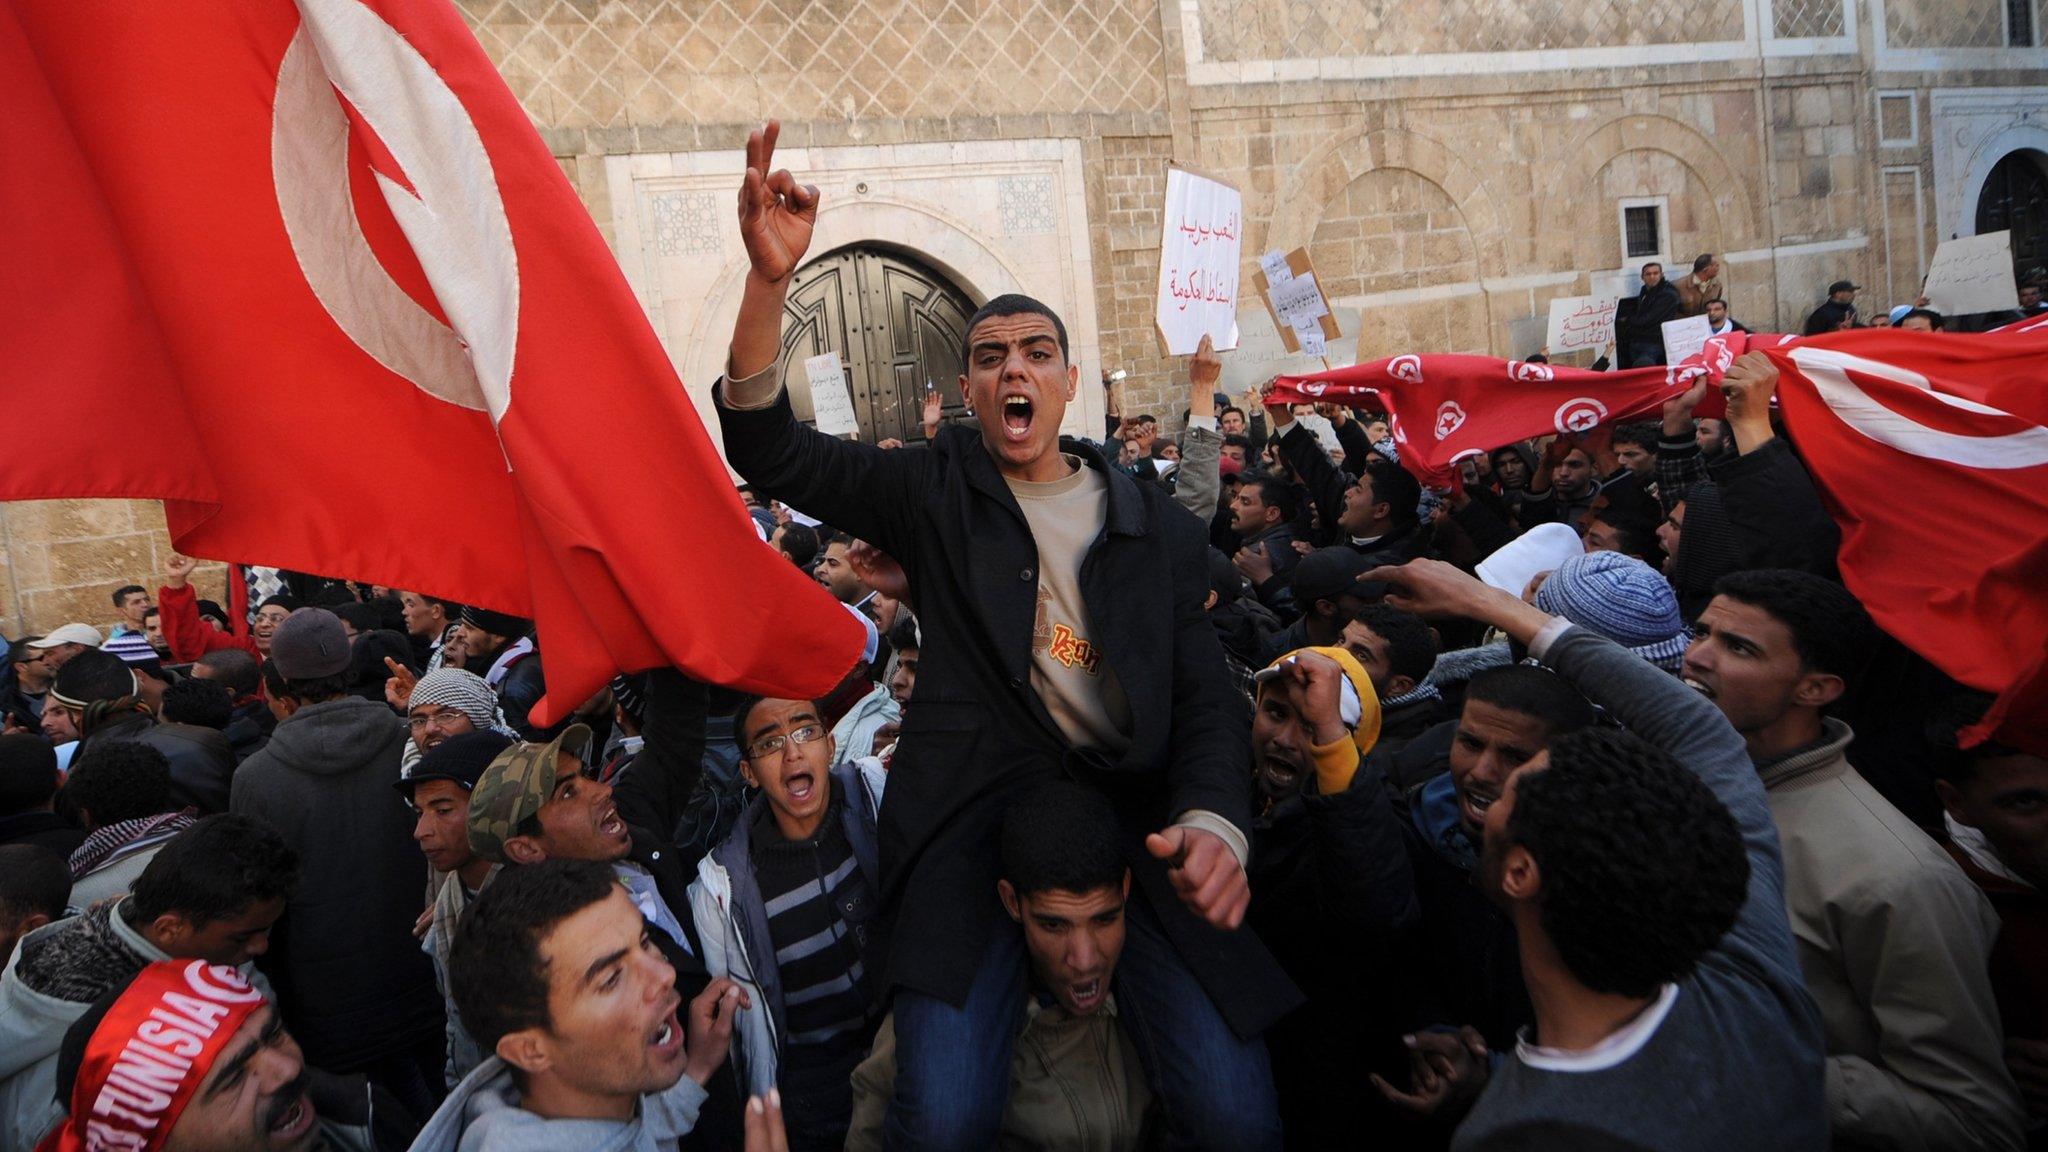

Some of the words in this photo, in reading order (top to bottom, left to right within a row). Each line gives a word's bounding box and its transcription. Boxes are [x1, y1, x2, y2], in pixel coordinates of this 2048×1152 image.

[1180, 214, 1211, 246] يريد
[1563, 311, 1614, 332] حكومة
[93, 991, 229, 1128] TUNISIA
